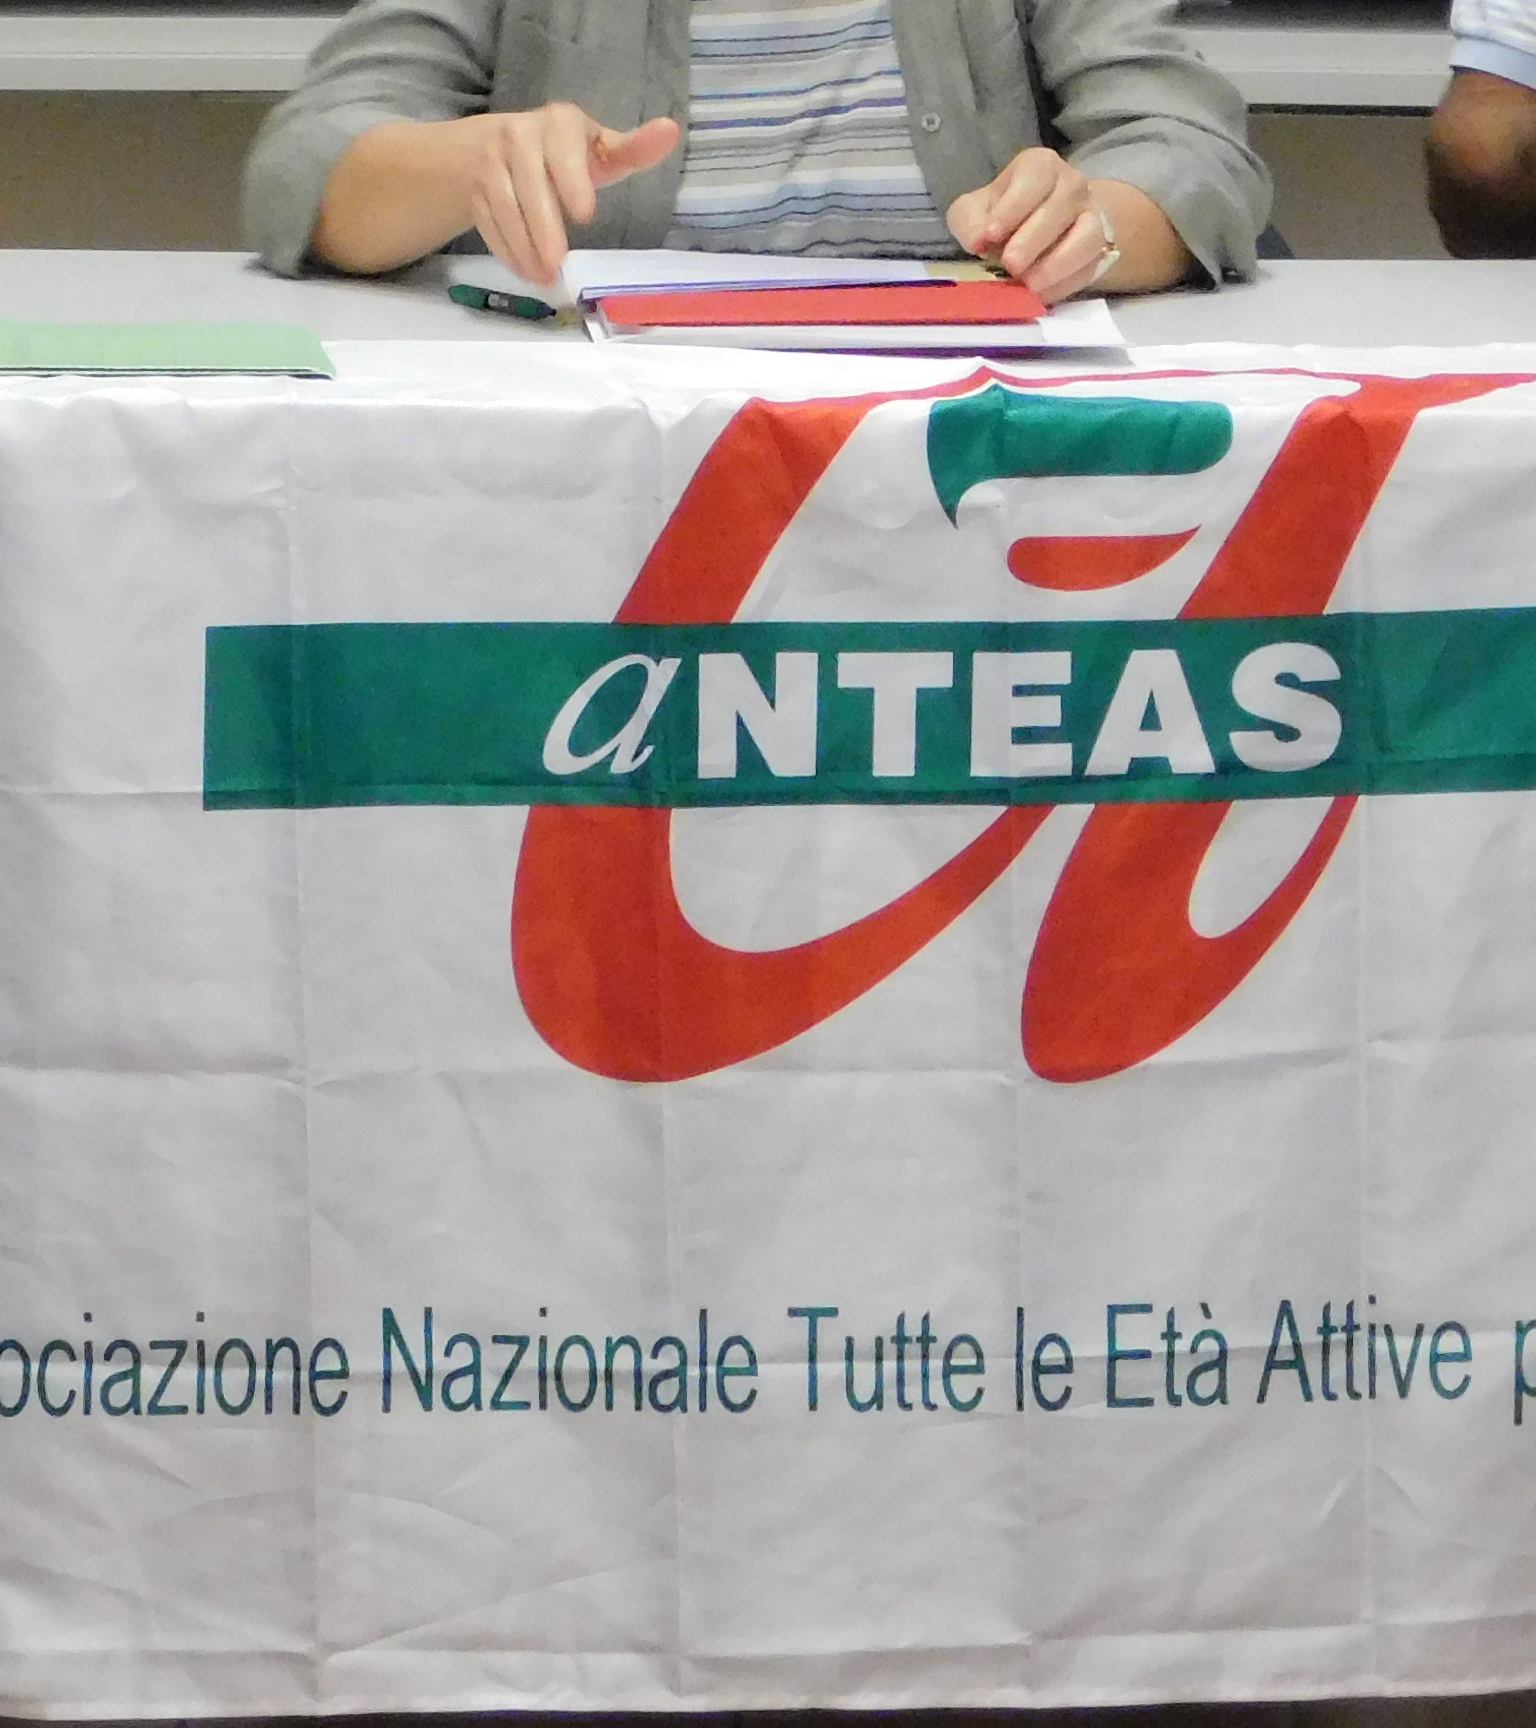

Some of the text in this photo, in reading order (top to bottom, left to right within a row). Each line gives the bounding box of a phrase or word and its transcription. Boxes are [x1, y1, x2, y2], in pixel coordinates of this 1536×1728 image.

[381, 1305, 760, 1415] Nazionale
[787, 1306, 986, 1414] Tutte
[1015, 1306, 1075, 1413] le
[1105, 1302, 1231, 1410] Età
[1256, 1294, 1475, 1405] Attive
